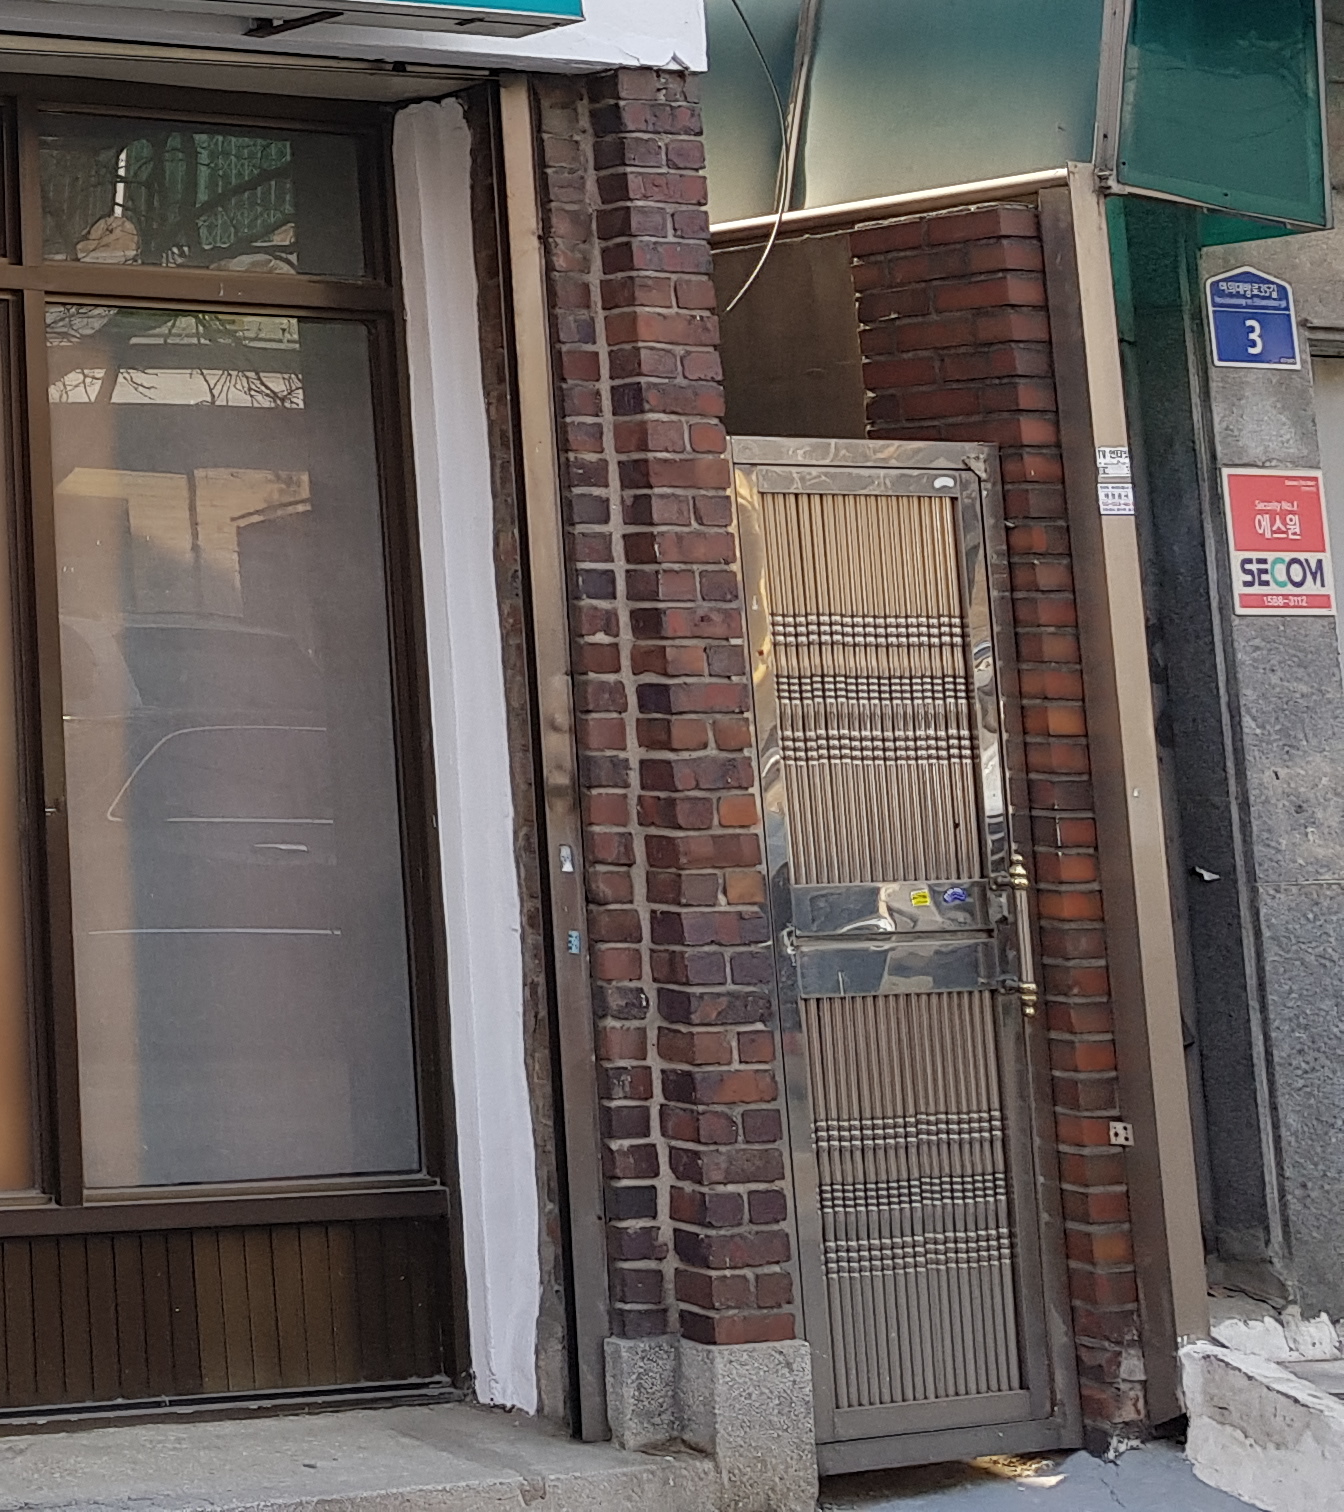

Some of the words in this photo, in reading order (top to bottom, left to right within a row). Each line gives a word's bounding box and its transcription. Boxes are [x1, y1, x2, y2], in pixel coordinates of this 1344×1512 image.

[1244, 319, 1263, 355] 3
[1254, 514, 1302, 540] 에스원
[1239, 556, 1326, 588] SECOM
